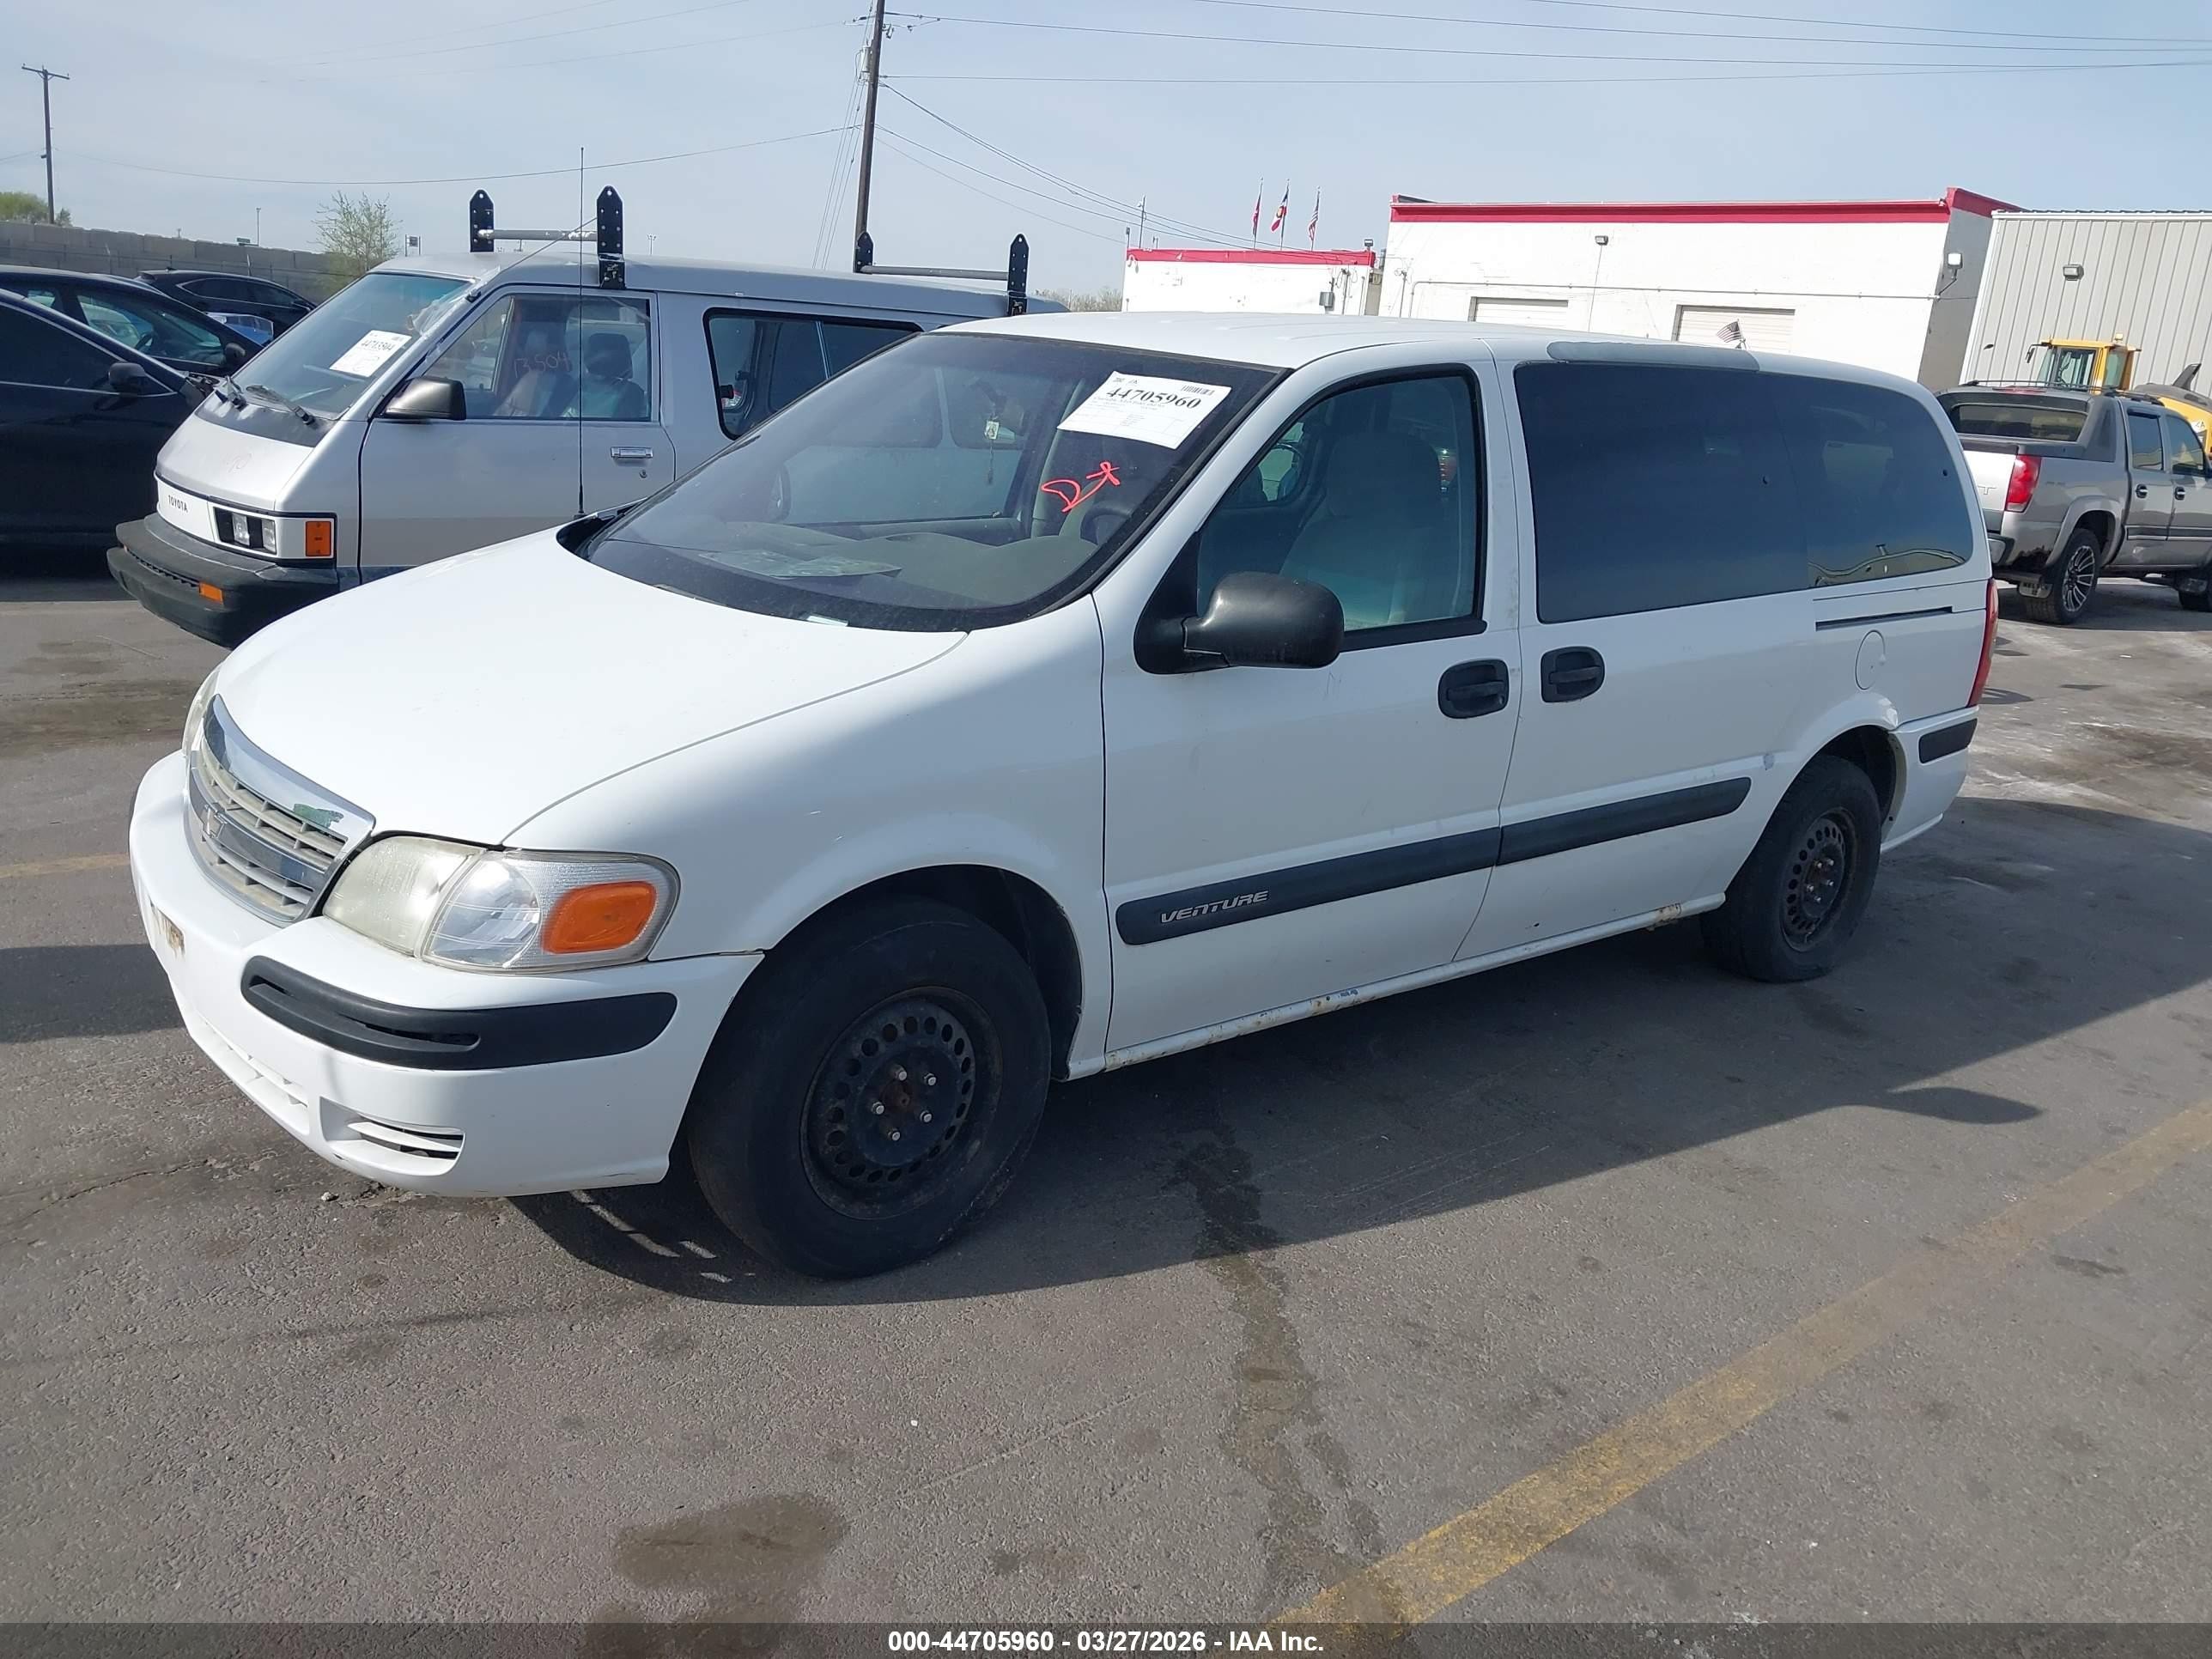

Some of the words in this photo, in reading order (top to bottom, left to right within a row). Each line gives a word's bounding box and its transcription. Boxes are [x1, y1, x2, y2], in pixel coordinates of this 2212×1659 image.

[1106, 387, 1202, 410] 44705960
[167, 495, 188, 513] TOYOTA
[1160, 890, 1269, 923] VENTURE
